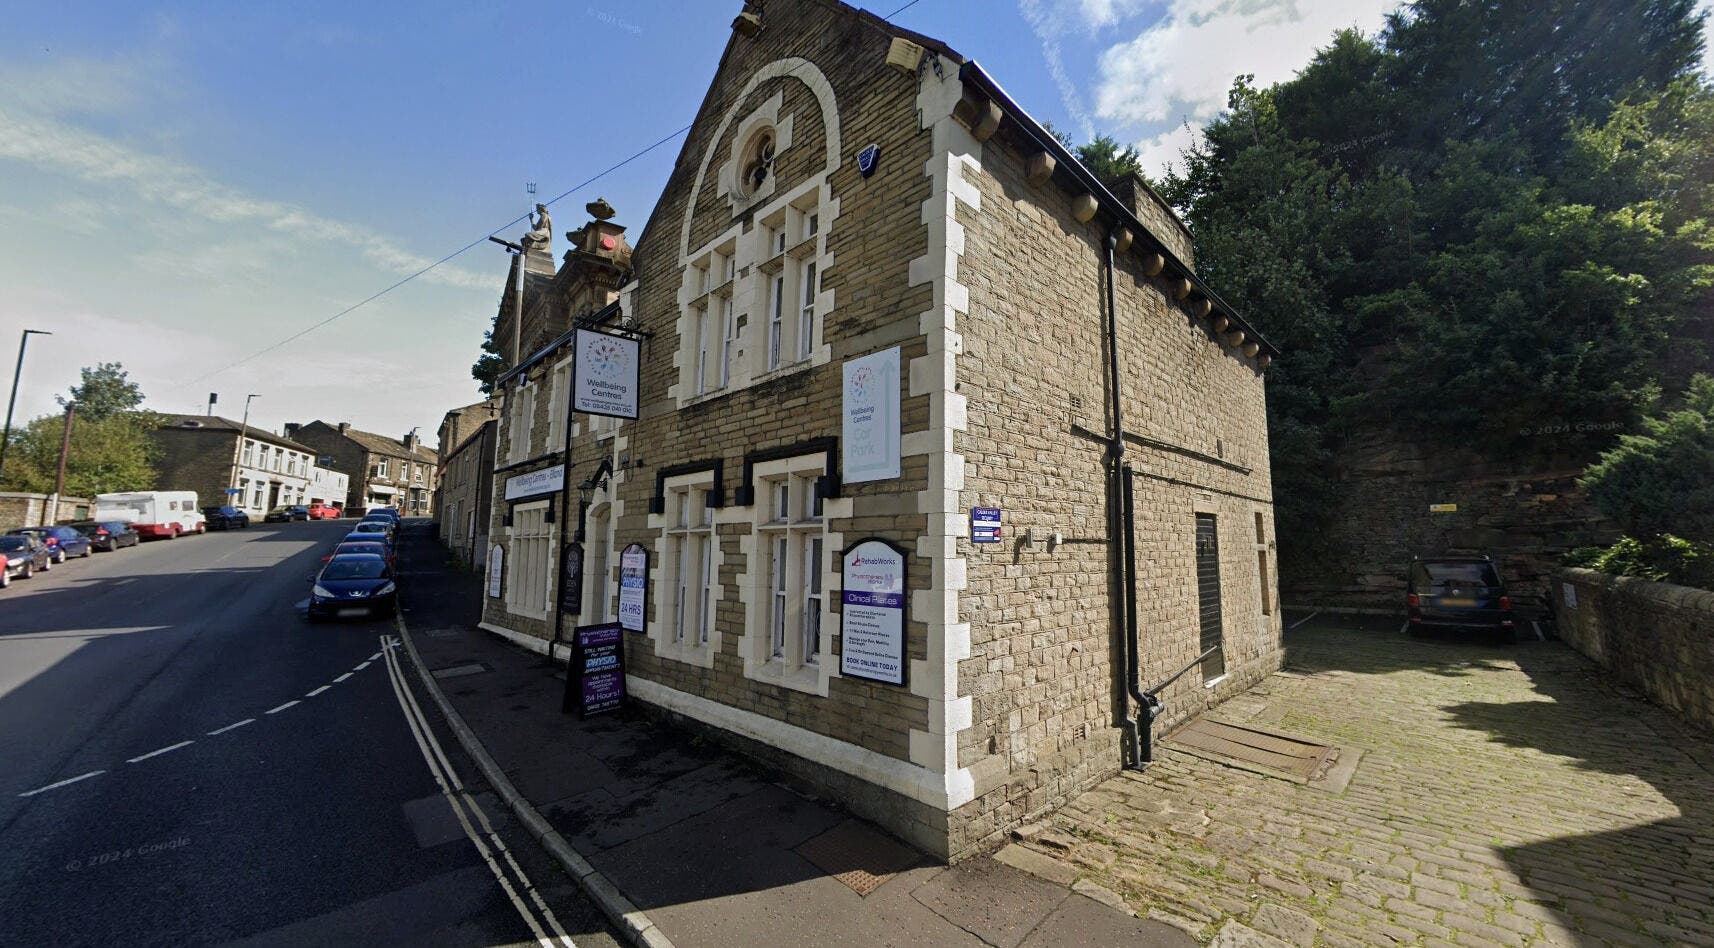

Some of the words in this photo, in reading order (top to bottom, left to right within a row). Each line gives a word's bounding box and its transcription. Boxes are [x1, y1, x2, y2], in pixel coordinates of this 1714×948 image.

[586, 380, 626, 393] Wellbeing
[592, 389, 622, 399] Centres
[850, 406, 874, 416] Wellbeing
[853, 415, 872, 424] Centres
[854, 429, 871, 440] Car
[851, 442, 874, 457] Park
[623, 577, 644, 588] PHYSIO
[621, 603, 627, 613] 24
[629, 604, 641, 615] HRS
[586, 656, 616, 667] PHYSIO
[861, 659, 878, 667] ONLINE
[880, 662, 897, 671] TODAY
[586, 694, 595, 702] 24
[597, 689, 620, 700] Hours!
